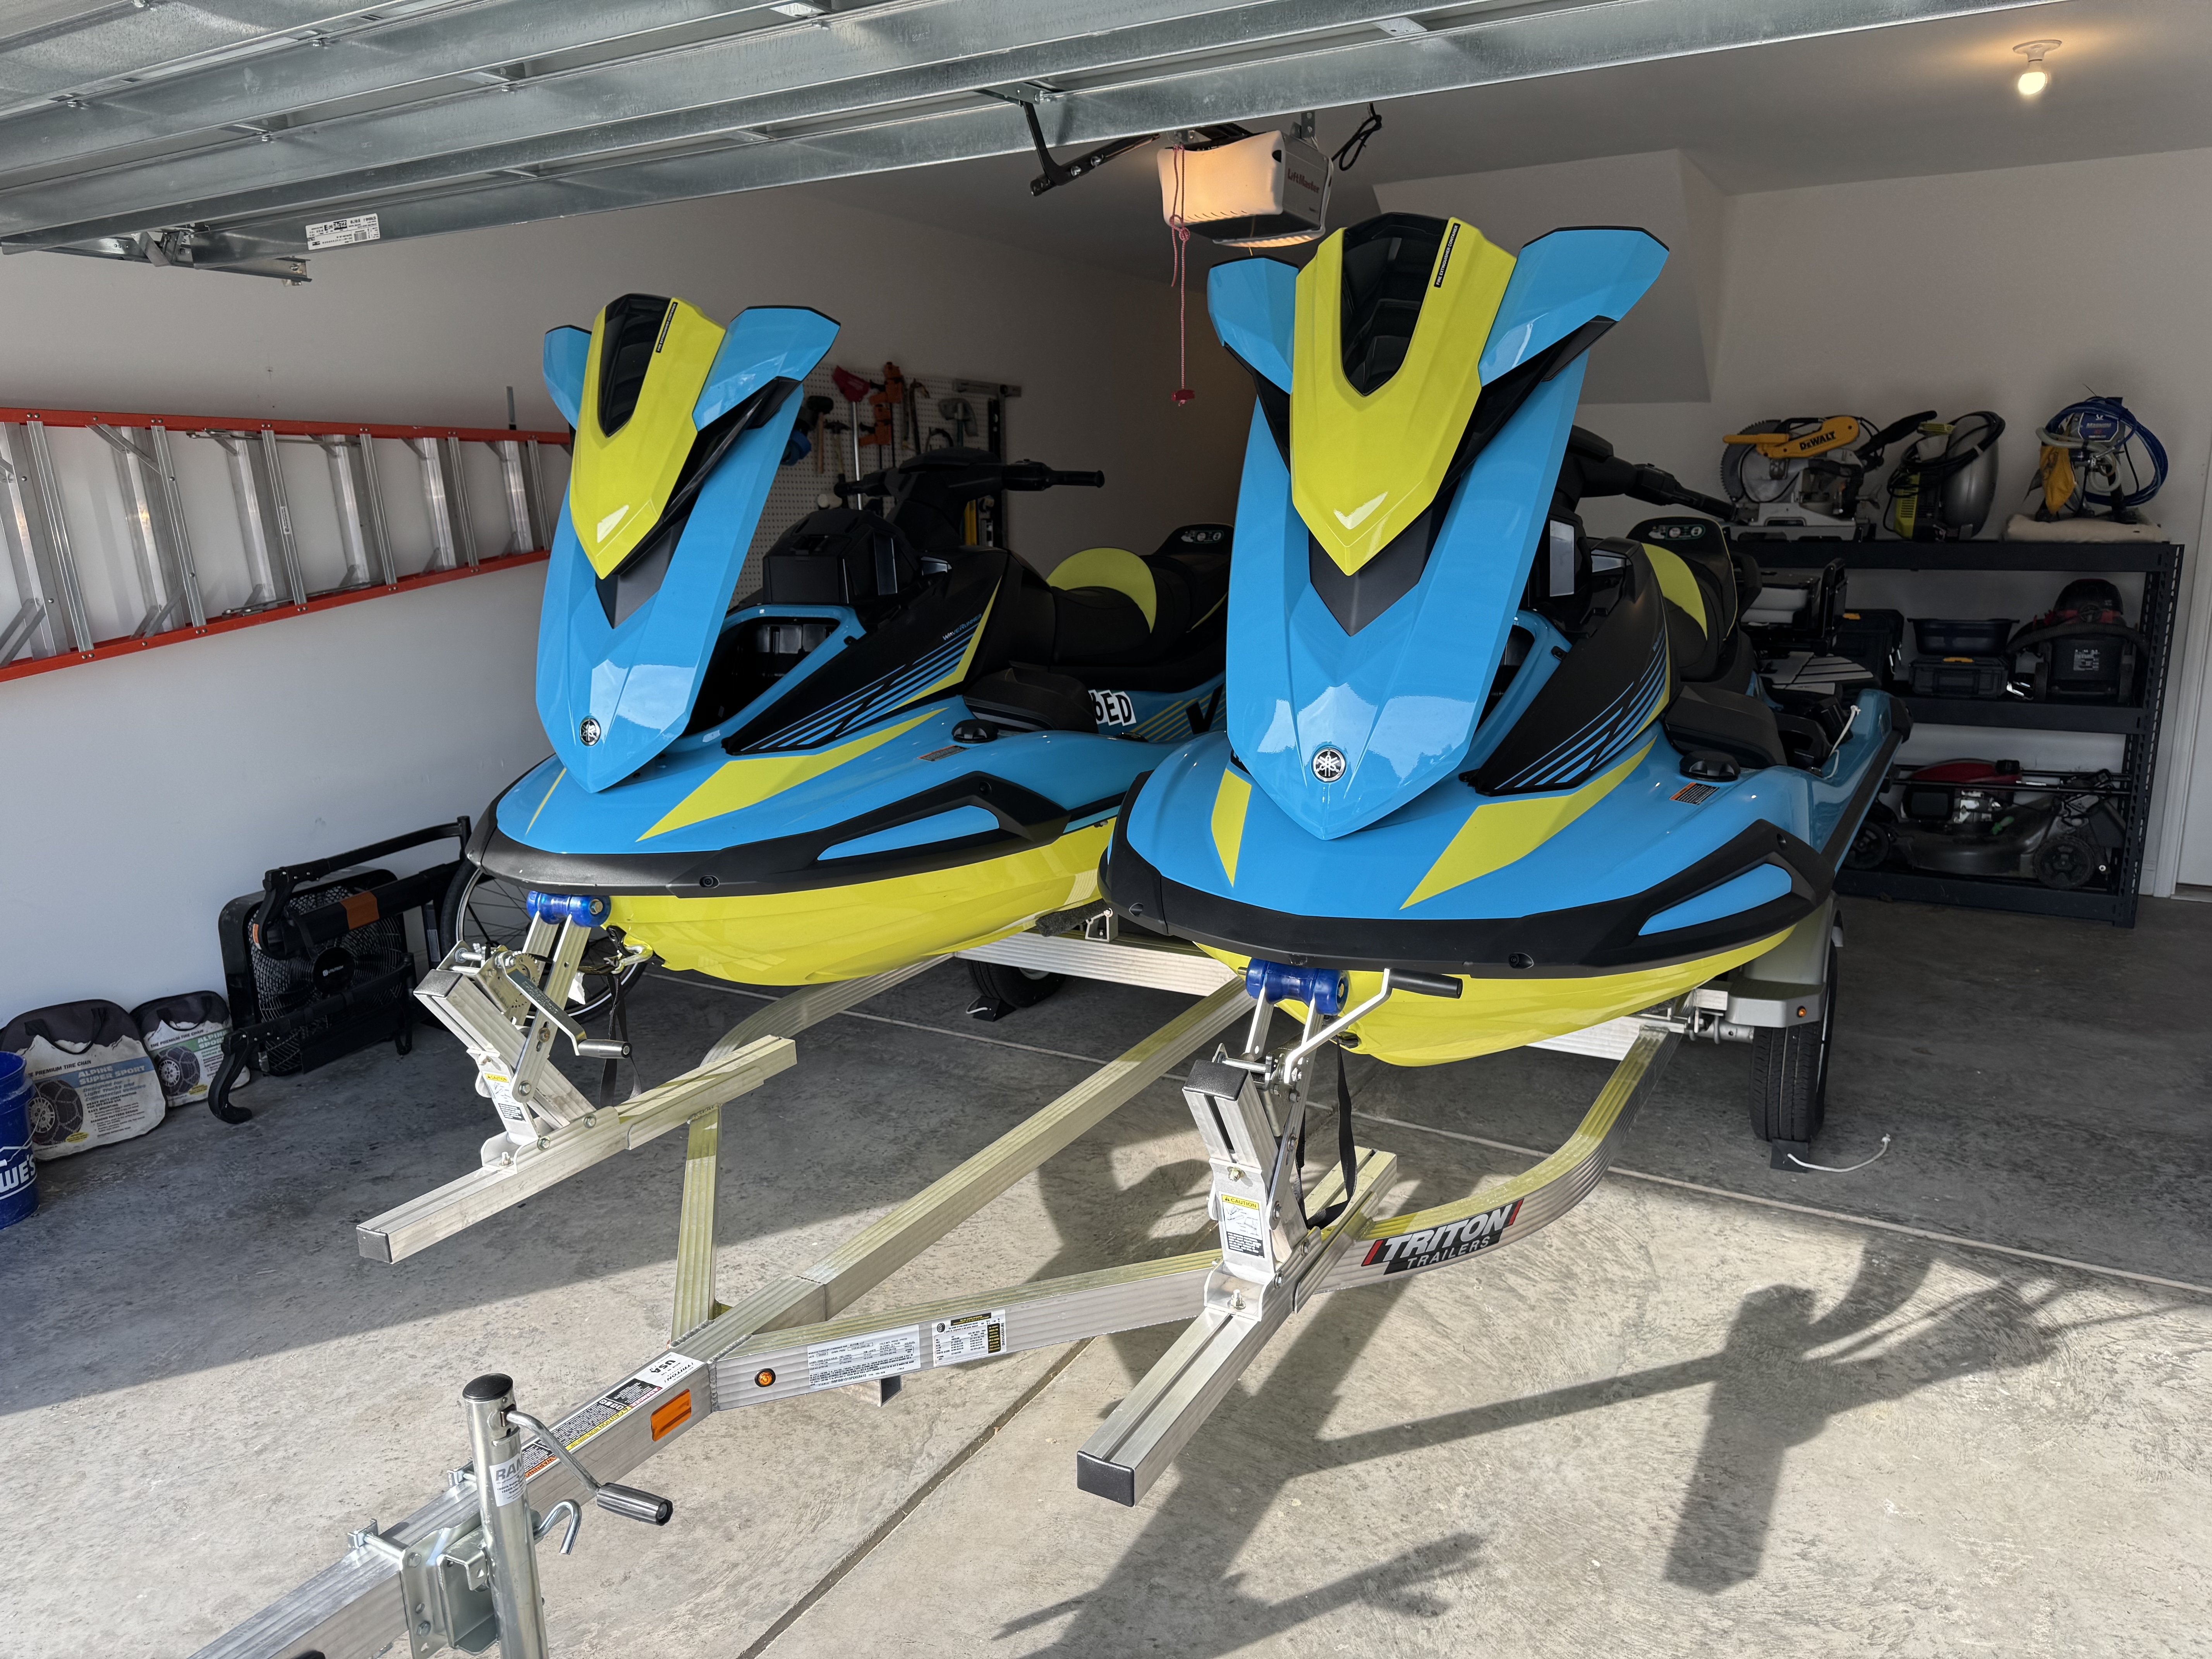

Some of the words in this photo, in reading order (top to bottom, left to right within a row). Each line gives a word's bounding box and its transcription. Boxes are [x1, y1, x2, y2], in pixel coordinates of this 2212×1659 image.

[1288, 168, 1319, 193] LiftMaster
[1438, 246, 1451, 276] EXTINGUISHER
[1448, 225, 1458, 247] CONTAINER
[1800, 431, 1835, 450] DEWALT
[160, 1036, 180, 1045] PREMIUM
[199, 1037, 223, 1048] SPOR
[35, 1066, 61, 1075] PREMIUM
[78, 1066, 112, 1077] ALPINE
[79, 1073, 113, 1085] SUPER
[115, 1065, 144, 1077] SPORT
[1230, 1198, 1257, 1208] CAUTION
[1384, 1204, 1512, 1261] TRITON
[1407, 1236, 1489, 1269] TRAILERS
[650, 1360, 675, 1373] USA
[666, 1364, 691, 1381] TRITON
[631, 1390, 654, 1407] DANGER
[598, 1410, 623, 1429] CAUTION
